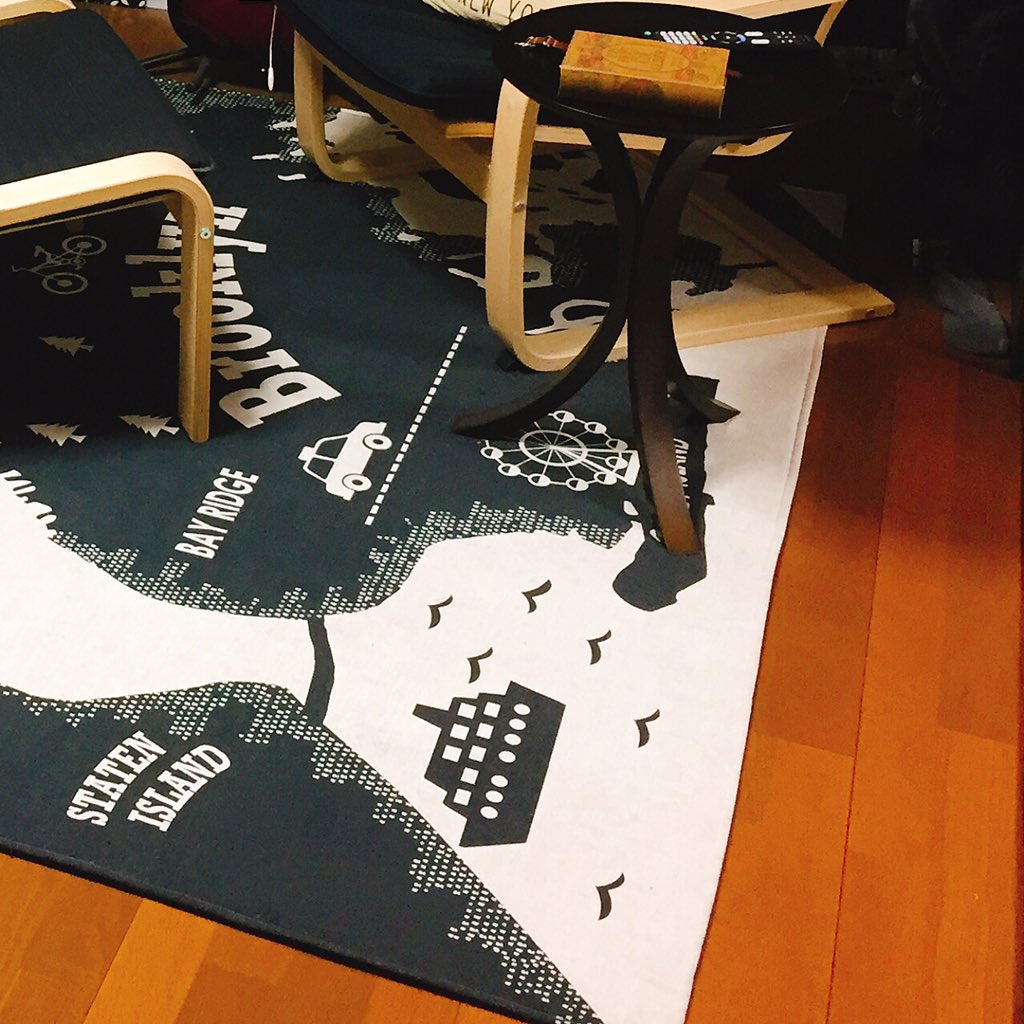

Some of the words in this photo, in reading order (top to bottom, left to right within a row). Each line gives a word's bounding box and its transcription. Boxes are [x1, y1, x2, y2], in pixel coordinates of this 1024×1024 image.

[201, 467, 259, 522] RIDGE
[175, 518, 228, 559] BAY
[66, 730, 167, 827] STATEN
[127, 744, 232, 832] ISLAND
